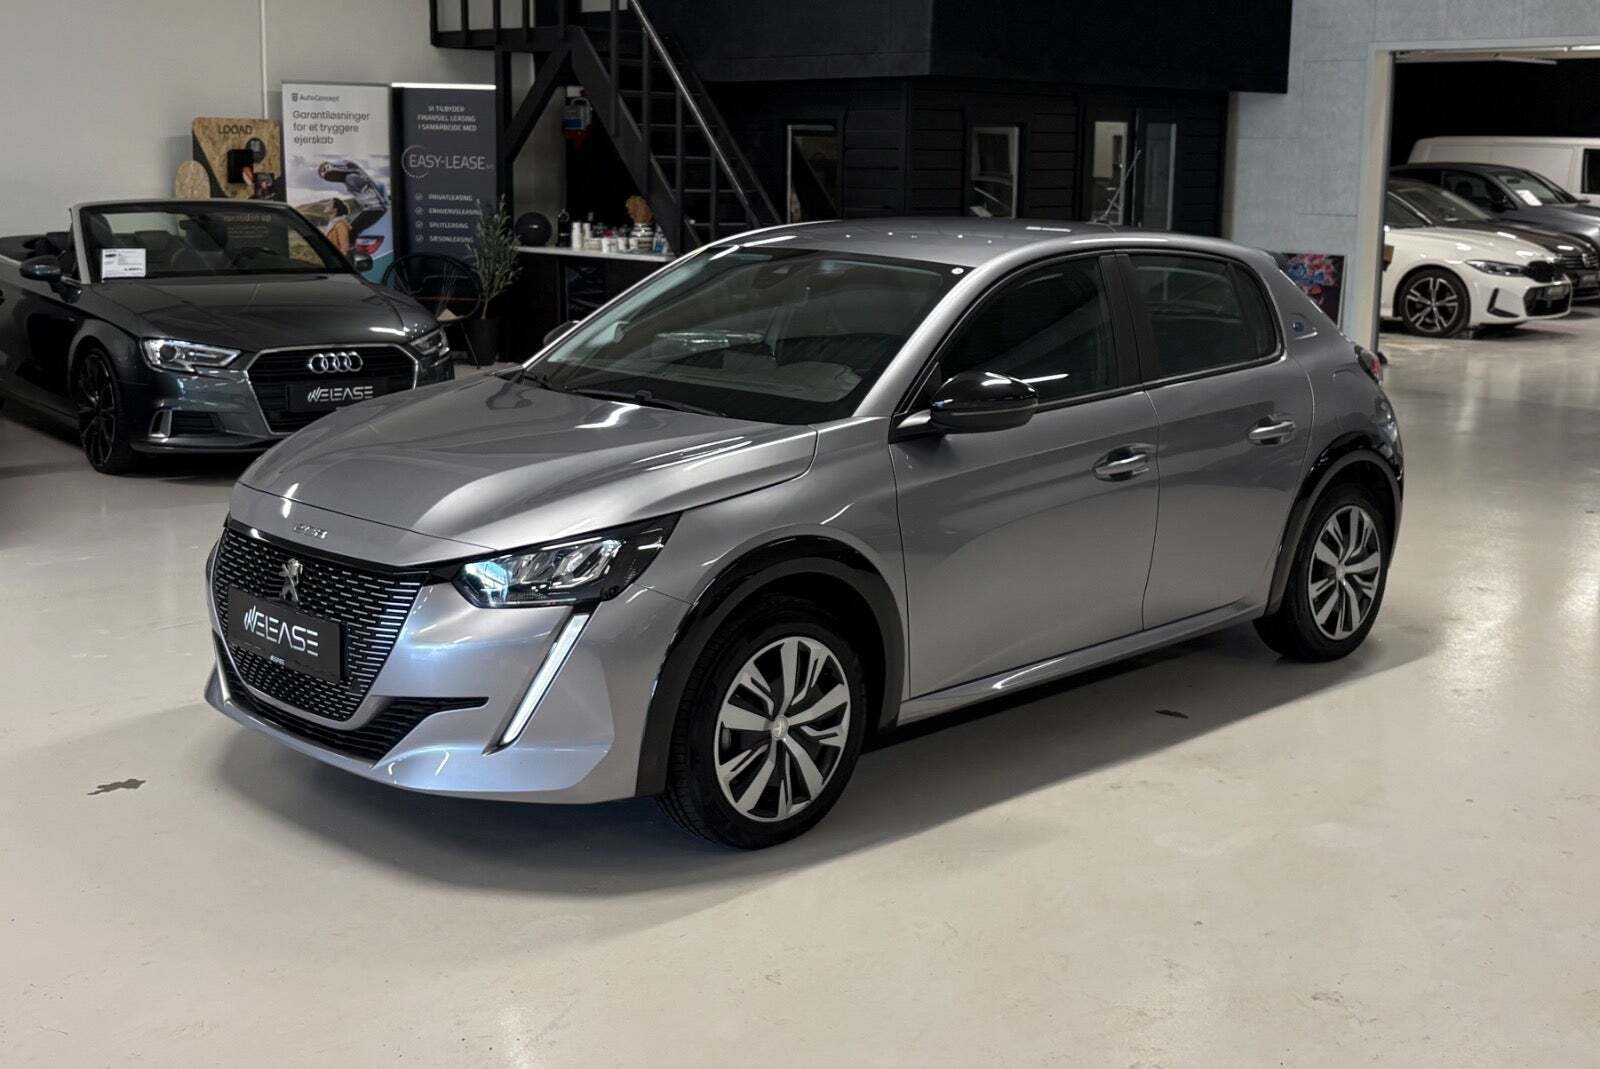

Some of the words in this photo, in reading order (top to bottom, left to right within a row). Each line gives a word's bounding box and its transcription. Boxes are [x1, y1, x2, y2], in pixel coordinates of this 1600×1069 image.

[292, 110, 371, 123] Garantiløsninger
[293, 122, 306, 132] for
[308, 124, 318, 132] et
[320, 124, 359, 135] tryggere
[462, 124, 477, 132] MED
[293, 136, 334, 146] ejerskab
[408, 154, 487, 170] EASY-LEASE
